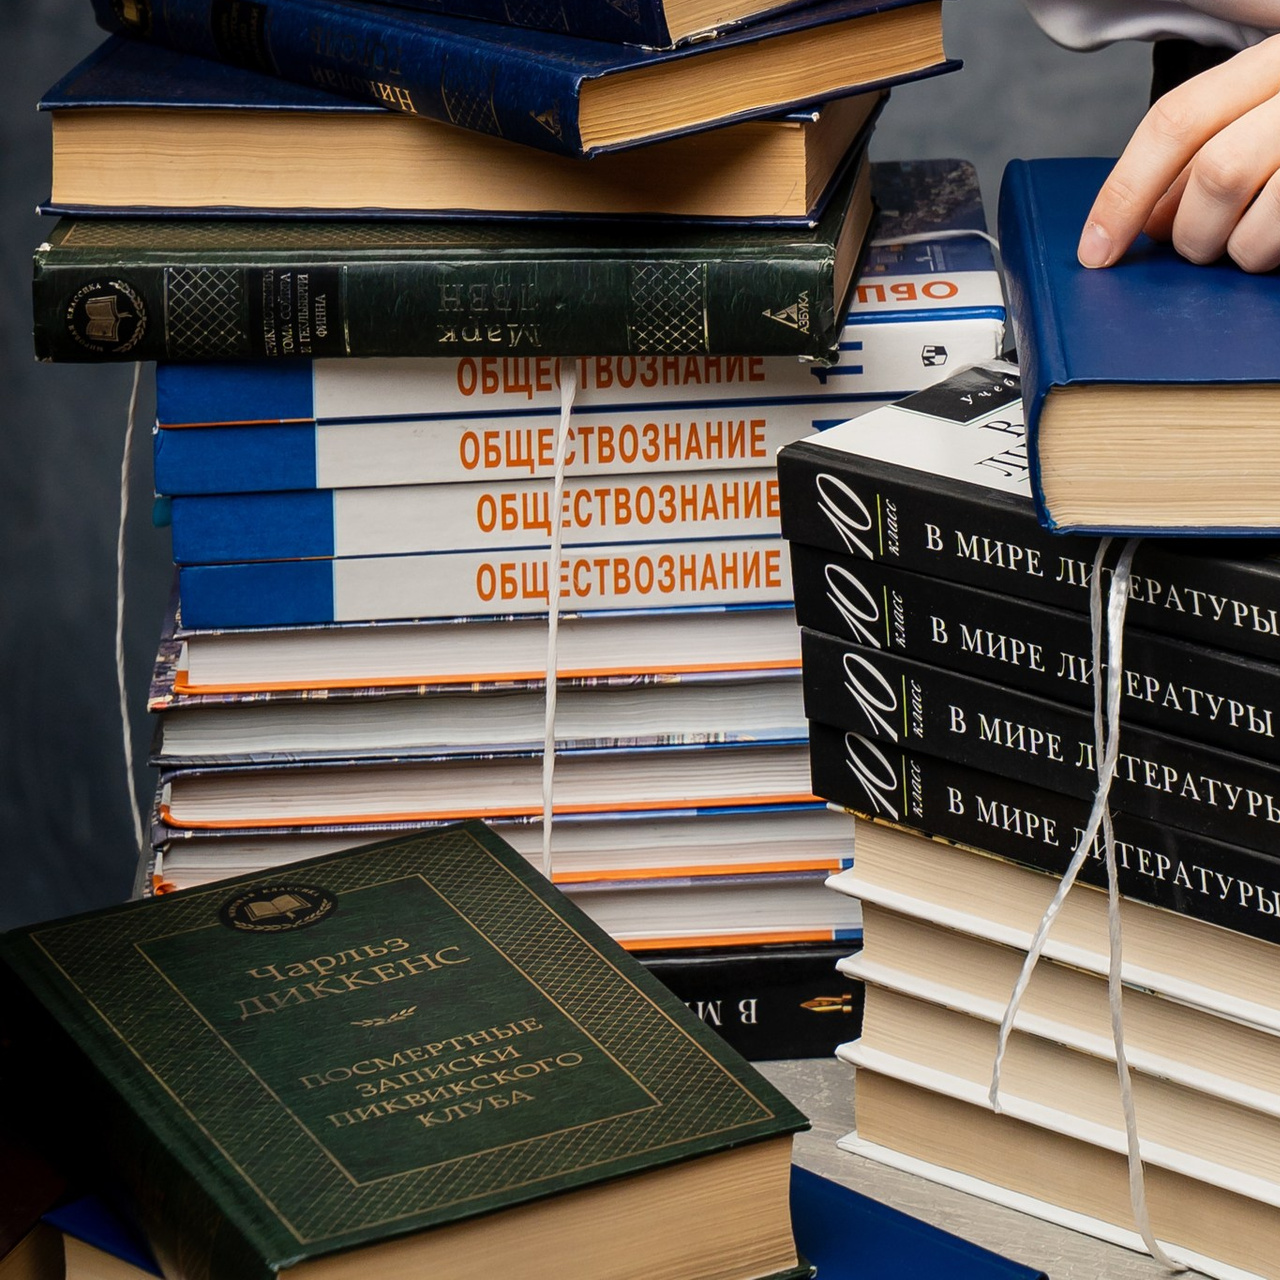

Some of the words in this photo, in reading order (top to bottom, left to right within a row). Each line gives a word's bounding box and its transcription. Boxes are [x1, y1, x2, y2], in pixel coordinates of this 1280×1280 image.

[280, 323, 295, 355] ТОМА
[314, 293, 328, 338] ФИННА
[436, 315, 543, 348] Марк
[799, 290, 809, 335] АЗБУКА
[456, 355, 766, 401] ОБЩЕТВОЗНАНИЕ
[476, 480, 781, 537] ОБЩЕСТВОЗНАНИЕ
[816, 473, 874, 561] 10
[885, 498, 900, 557] класс
[476, 550, 782, 606] ОБЩЕСТВОЗНАНИЕ
[924, 523, 944, 551] В
[954, 530, 1044, 577] МИРЕ
[824, 563, 882, 649] 10
[892, 590, 906, 648] класс
[843, 653, 899, 743] 10
[930, 615, 948, 644] В
[959, 623, 1045, 672] МИРЕ
[1057, 651, 1275, 738] ЛИЕРАТУРЫ
[910, 679, 924, 739] класс
[948, 705, 967, 734] В
[977, 713, 1064, 762] МИРЕ
[844, 731, 899, 821] 10
[910, 759, 924, 818] класс
[947, 786, 965, 815] В
[975, 795, 1059, 847] МИРЕ
[233, 945, 471, 1022] ДИККЕНС
[249, 937, 410, 983] Чарльз
[684, 1000, 723, 1026] М
[738, 998, 758, 1024] В
[298, 1016, 544, 1091] ПОСМЕРТНЫЕ
[355, 1044, 523, 1098] ЗАПИСКИ
[325, 1051, 584, 1129] ПИКВИКСКОГО
[416, 1089, 537, 1129] КЛУБА
